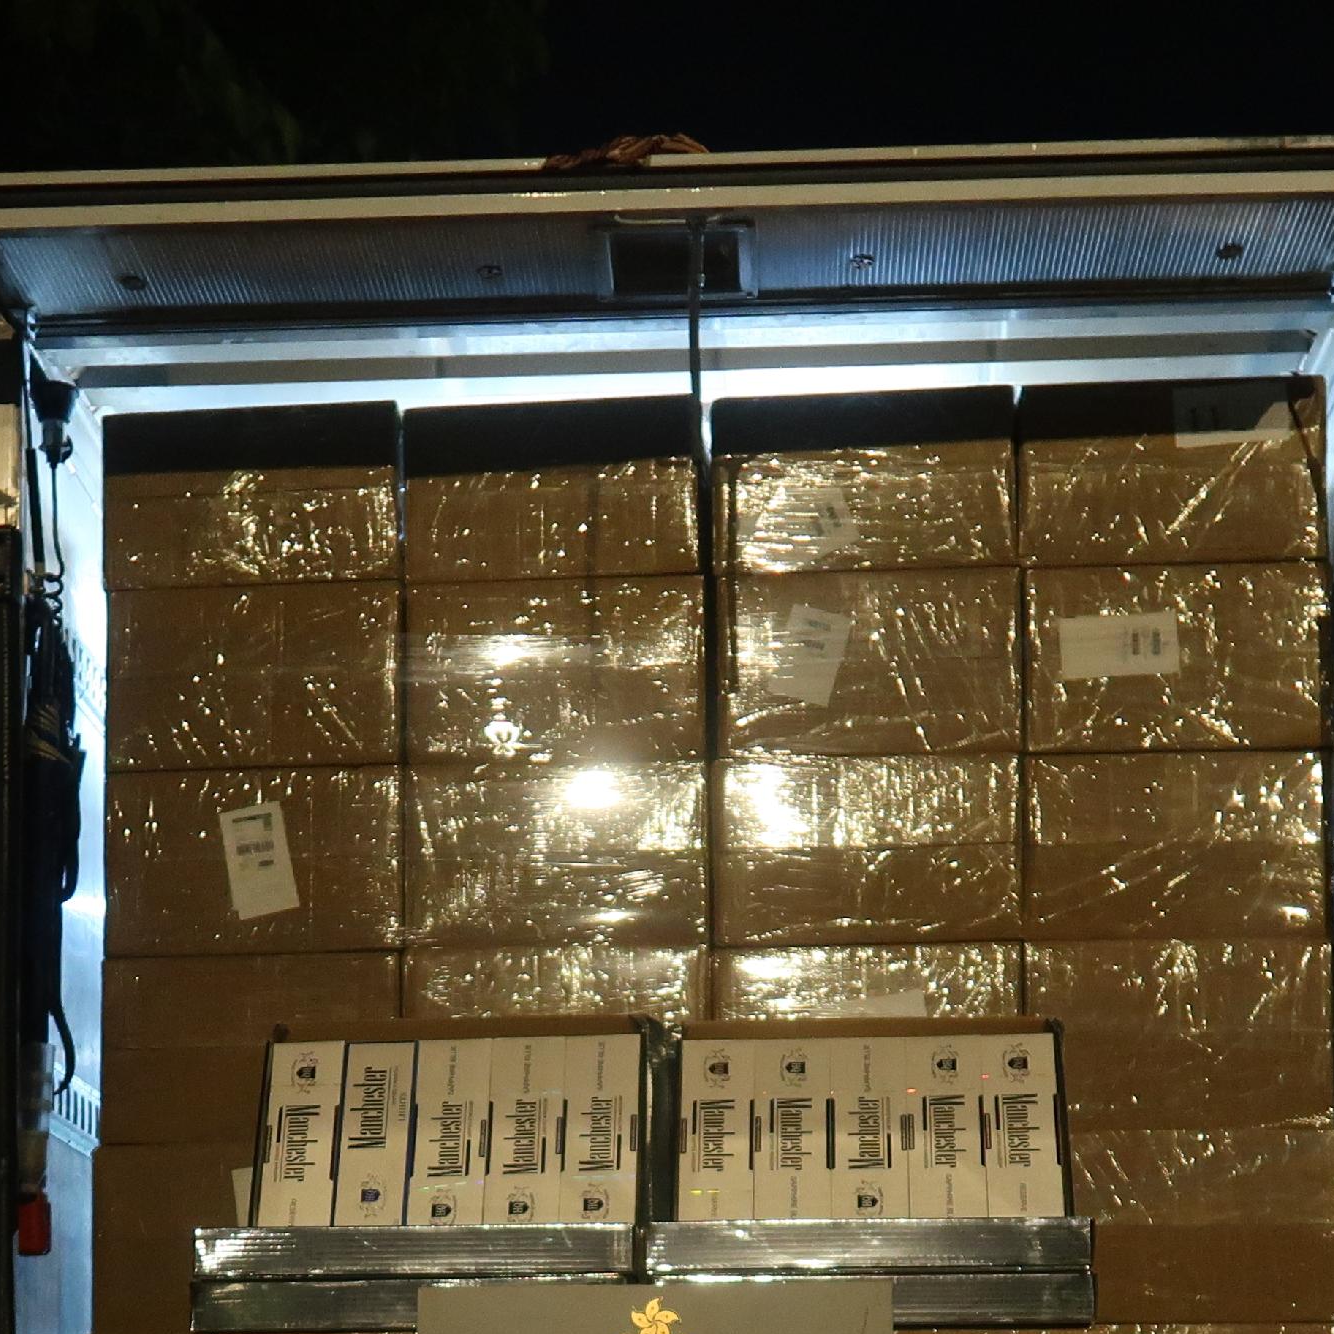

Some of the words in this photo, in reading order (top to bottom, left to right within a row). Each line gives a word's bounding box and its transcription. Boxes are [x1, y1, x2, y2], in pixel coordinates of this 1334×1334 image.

[283, 1104, 321, 1182] Manchester
[347, 1066, 388, 1150] Manchester
[427, 1100, 464, 1177] Manchester
[503, 1098, 539, 1174] Manchester
[579, 1096, 614, 1171] Manchester
[701, 1099, 736, 1172] Manchester
[779, 1098, 813, 1170] Manchester
[848, 1096, 884, 1169] Manchester
[932, 1094, 967, 1168] Manchester
[1002, 1093, 1040, 1167] Manchester
